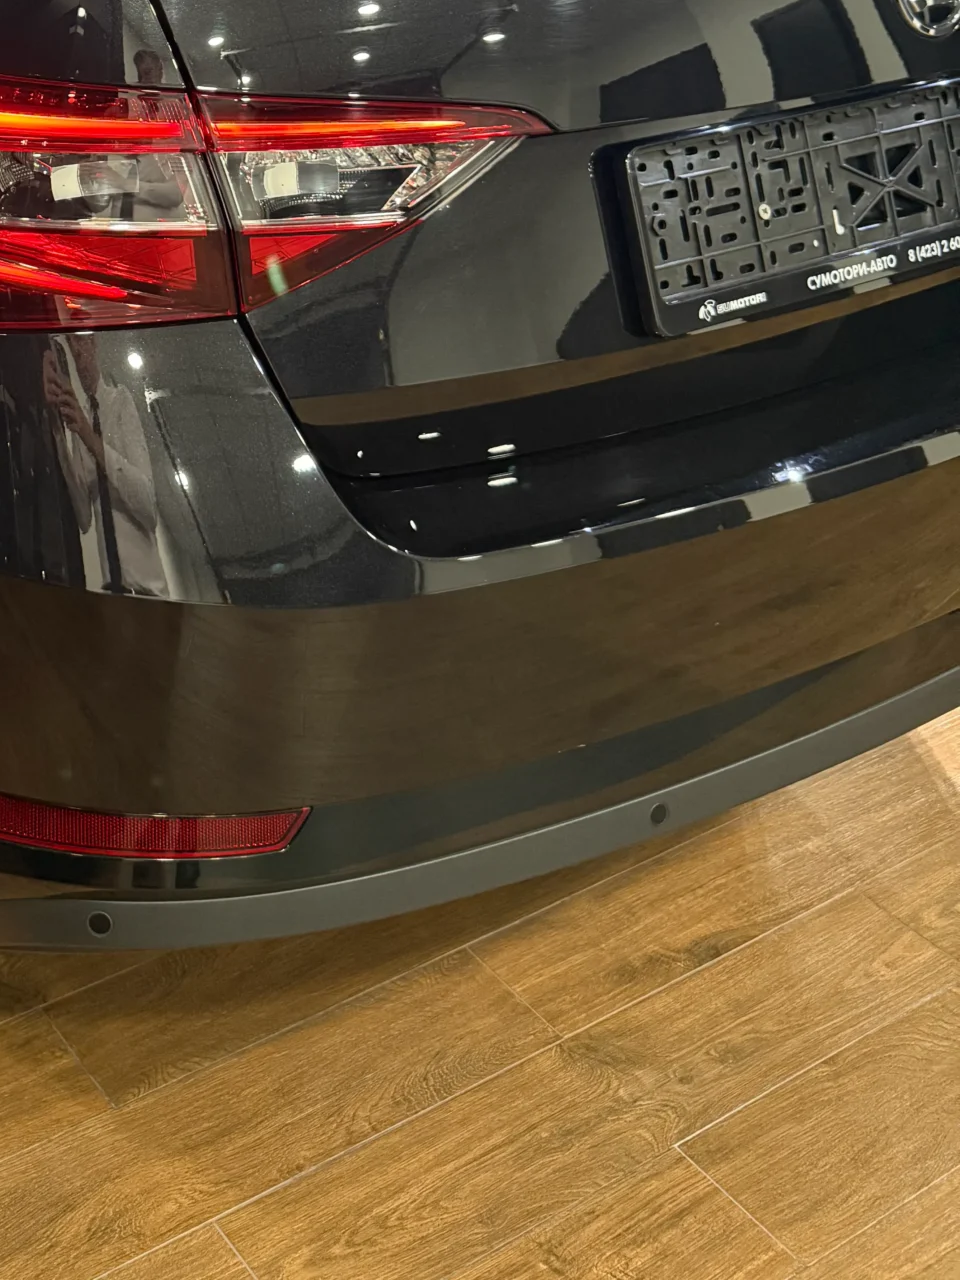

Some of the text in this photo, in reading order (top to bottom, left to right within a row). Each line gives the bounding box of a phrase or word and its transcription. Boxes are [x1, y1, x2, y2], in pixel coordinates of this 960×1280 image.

[807, 254, 897, 290] СУМОТОРИ-АВТО
[908, 249, 916, 262] 8
[916, 240, 941, 262] (423)
[941, 239, 950, 252] 2
[716, 292, 767, 314] SUMOTORI
